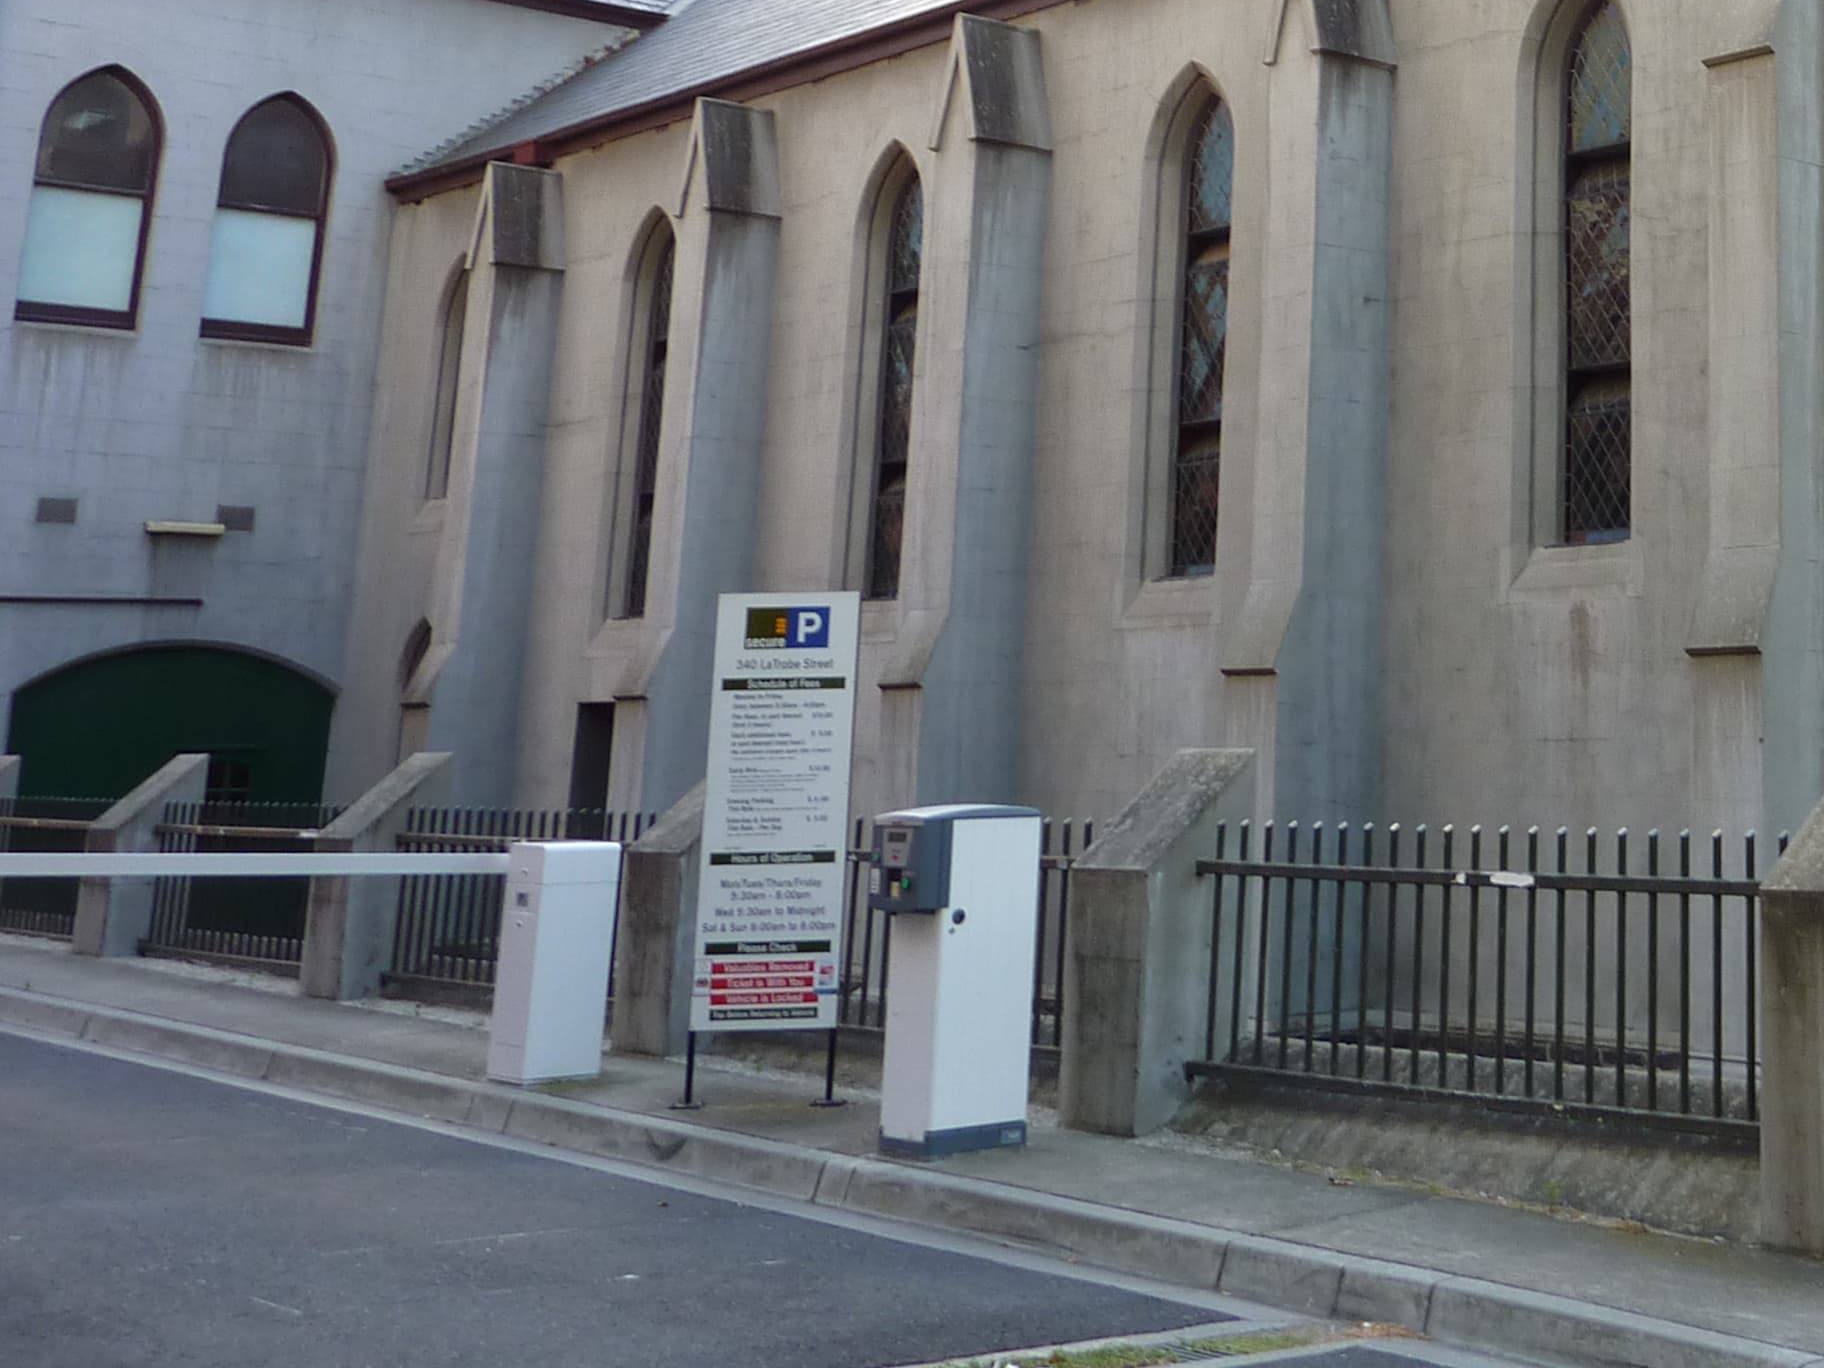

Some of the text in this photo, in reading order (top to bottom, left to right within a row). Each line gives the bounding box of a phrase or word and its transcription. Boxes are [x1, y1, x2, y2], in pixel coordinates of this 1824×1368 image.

[797, 611, 823, 643] P
[803, 656, 834, 669] Street
[731, 854, 758, 863] Hours
[769, 942, 797, 952] Check
